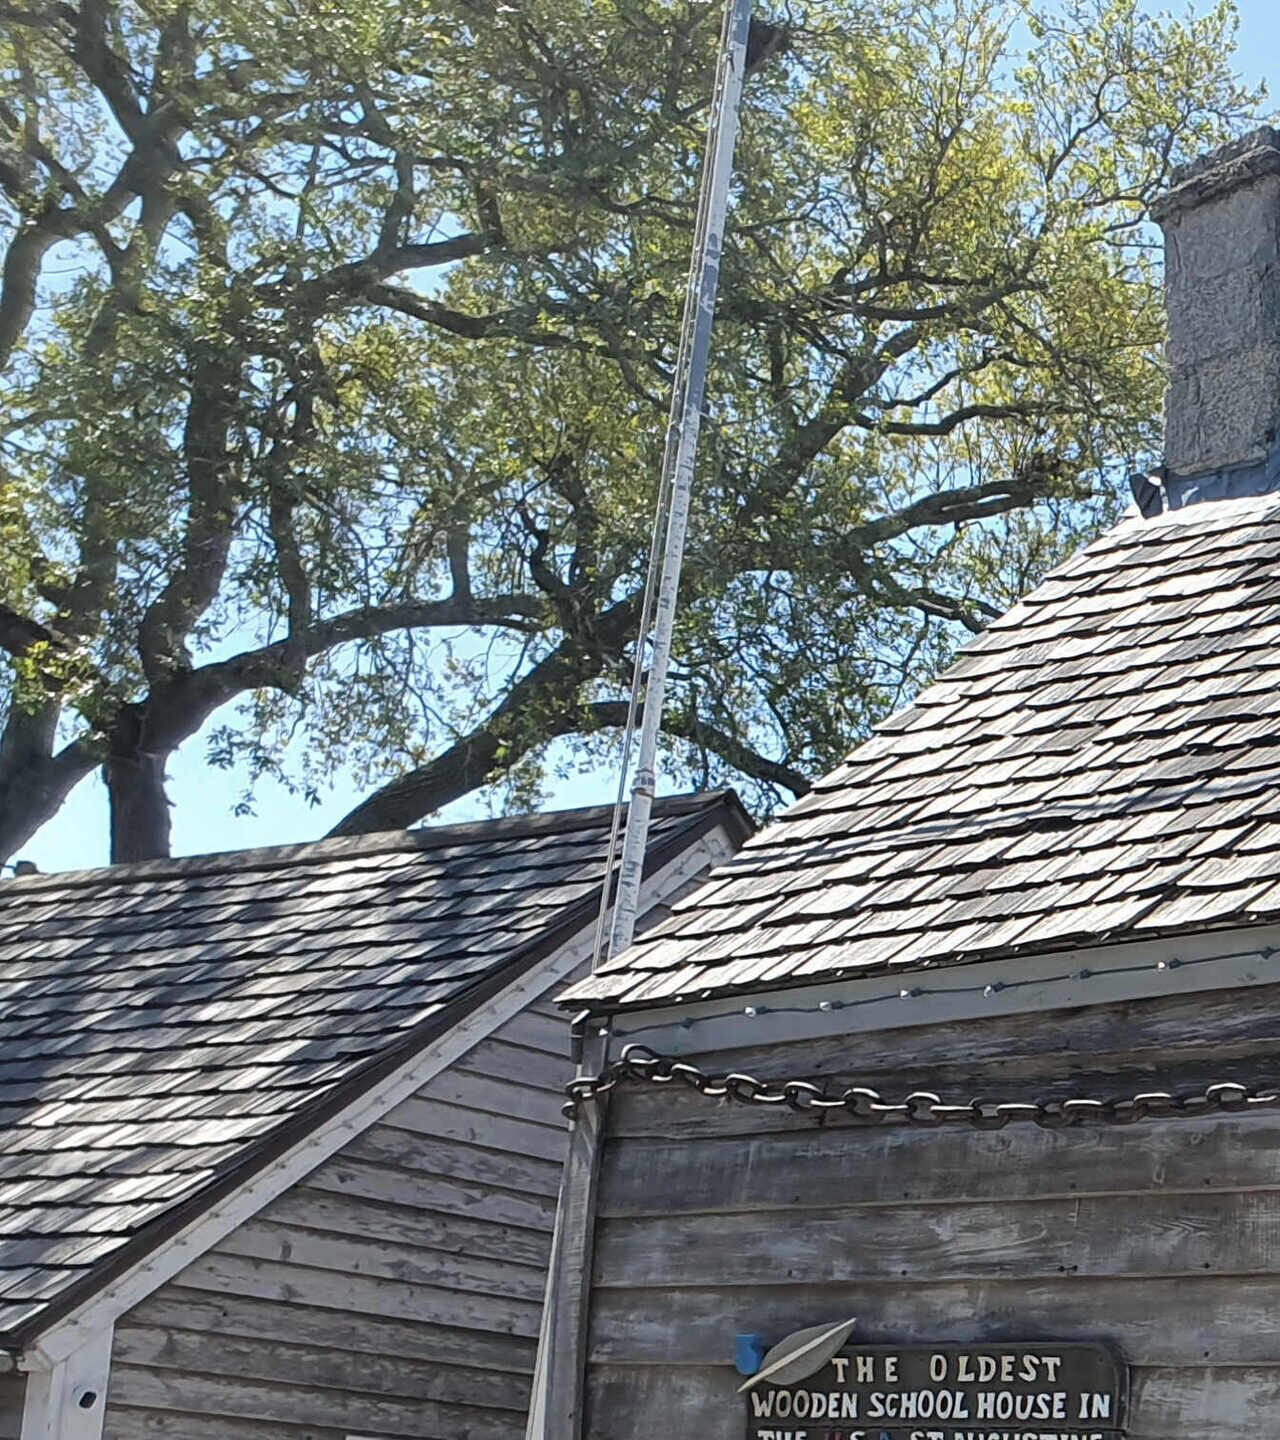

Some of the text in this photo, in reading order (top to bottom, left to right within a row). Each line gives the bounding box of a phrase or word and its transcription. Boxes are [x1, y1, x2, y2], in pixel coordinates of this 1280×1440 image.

[831, 1354, 1062, 1383] THE OLDEST
[751, 1389, 1111, 1420] WOODEN SCHOOL HOUSE IN
